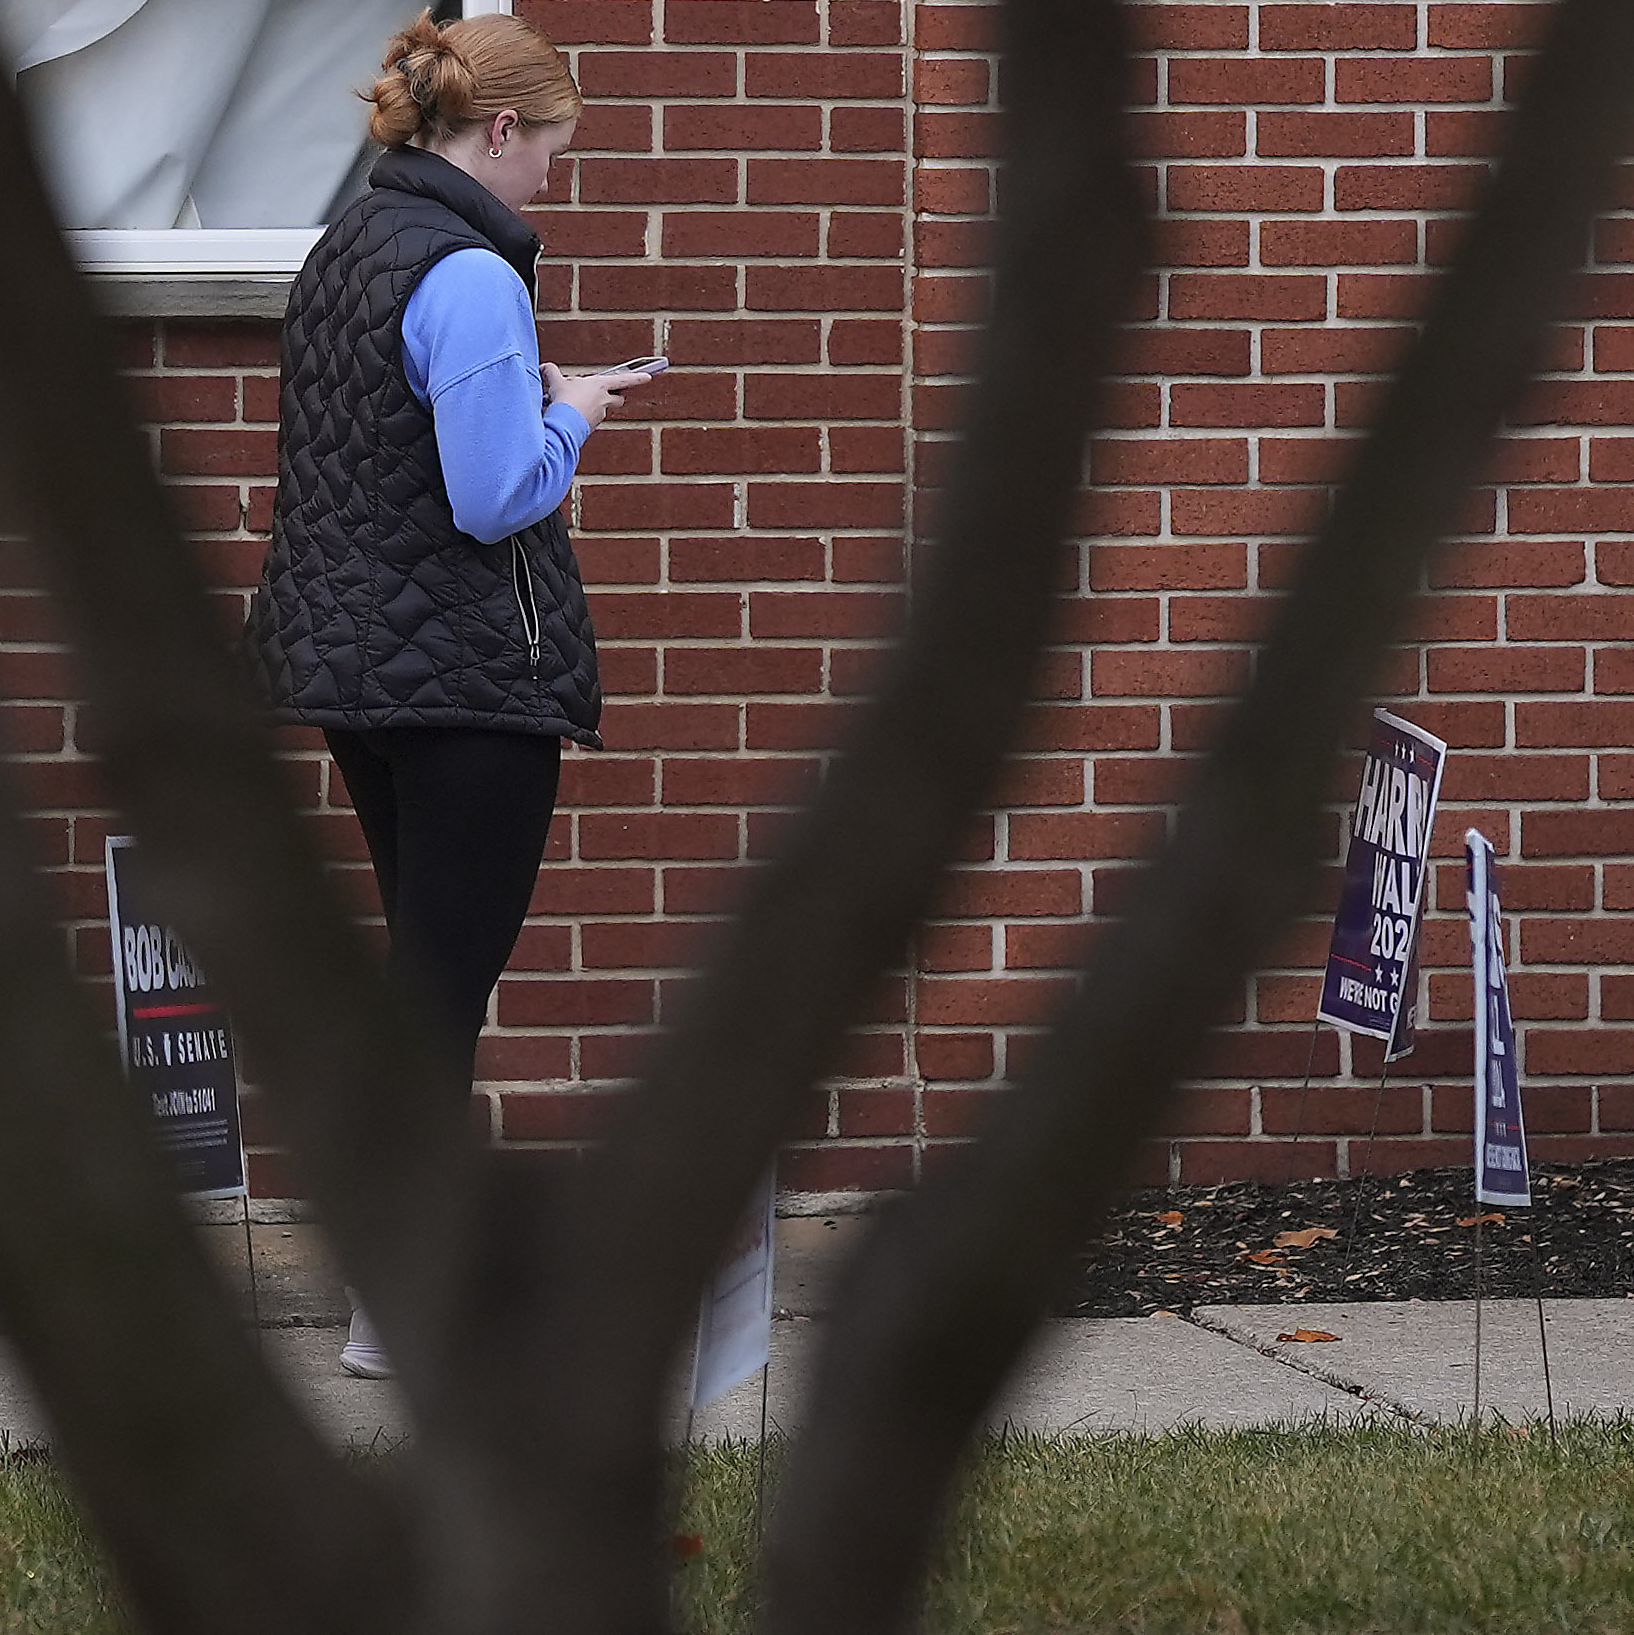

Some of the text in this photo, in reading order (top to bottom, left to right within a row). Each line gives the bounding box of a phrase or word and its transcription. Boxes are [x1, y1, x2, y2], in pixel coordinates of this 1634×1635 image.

[1354, 754, 1430, 857] HARR
[1372, 851, 1422, 915] WAL
[124, 924, 165, 992] BOB
[1370, 913, 1410, 962] 202
[1365, 985, 1387, 1012] NOT
[133, 1028, 229, 1067] U.S. SENATE
